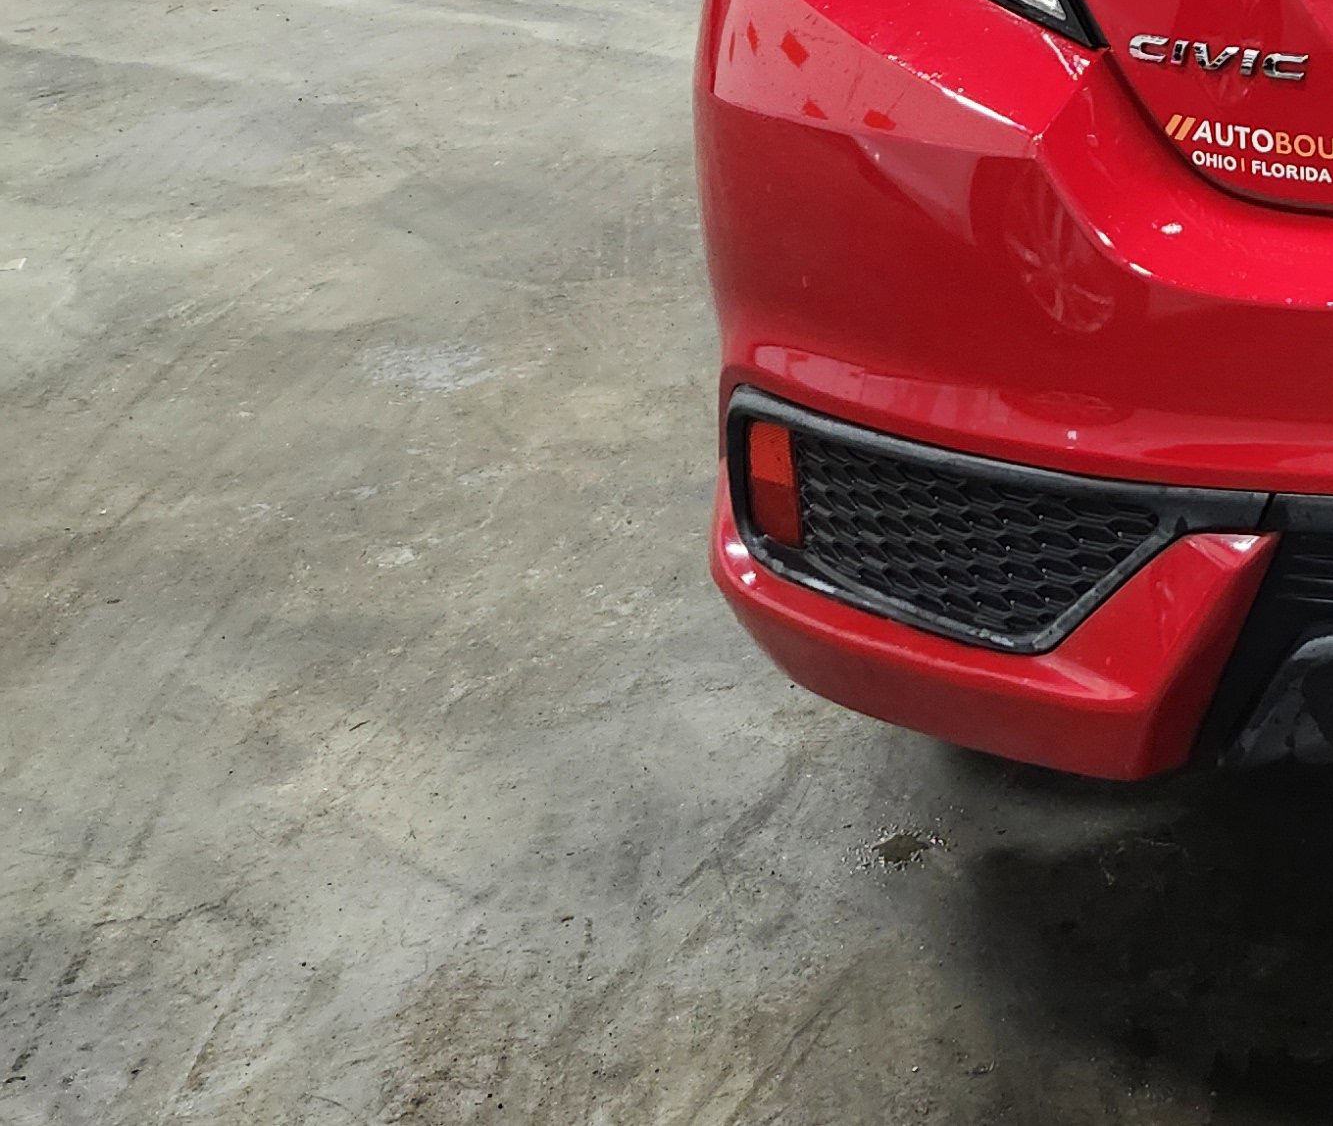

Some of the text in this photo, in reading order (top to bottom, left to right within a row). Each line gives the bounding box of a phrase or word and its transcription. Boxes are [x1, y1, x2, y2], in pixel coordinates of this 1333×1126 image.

[1129, 34, 1309, 80] CIVIC
[1191, 150, 1238, 171] OHIO
[1251, 160, 1333, 184] FLORIDA
